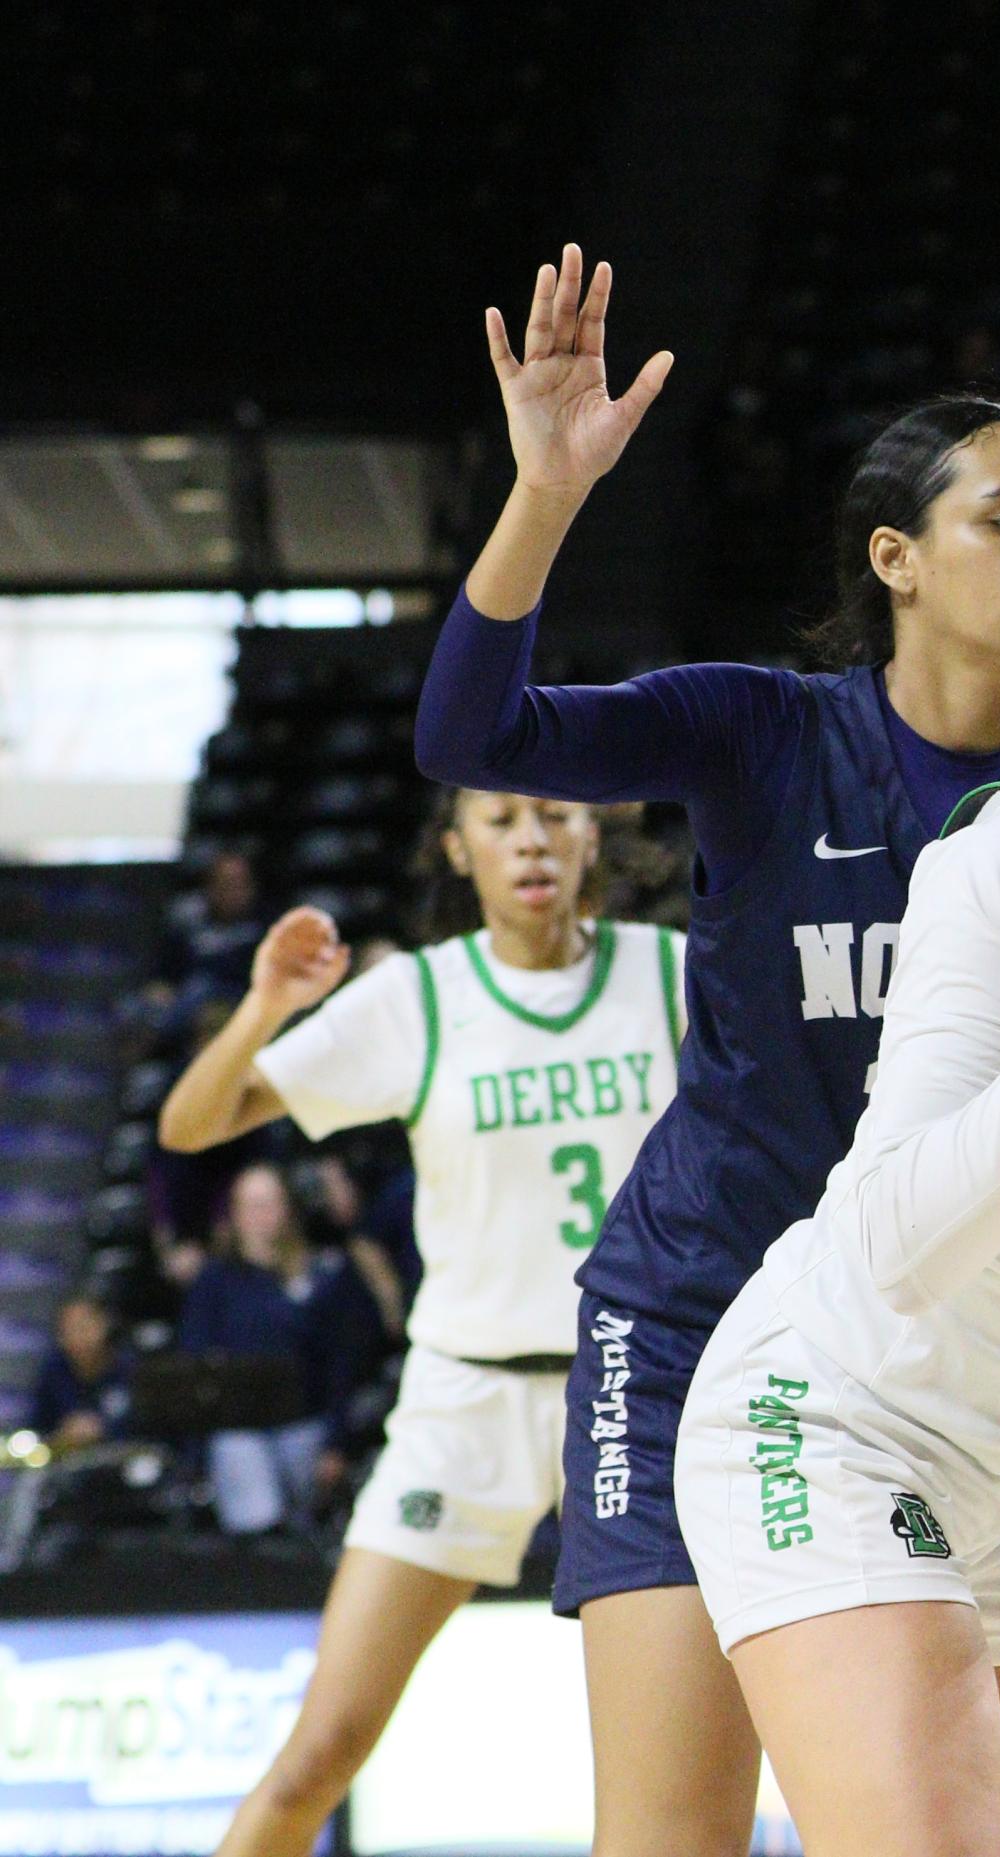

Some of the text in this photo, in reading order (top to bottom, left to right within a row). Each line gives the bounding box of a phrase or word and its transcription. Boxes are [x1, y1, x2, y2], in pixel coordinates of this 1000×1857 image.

[470, 1052, 653, 1133] DERBY
[551, 1142, 608, 1249] 3
[591, 1311, 635, 1519] MUSTANGS
